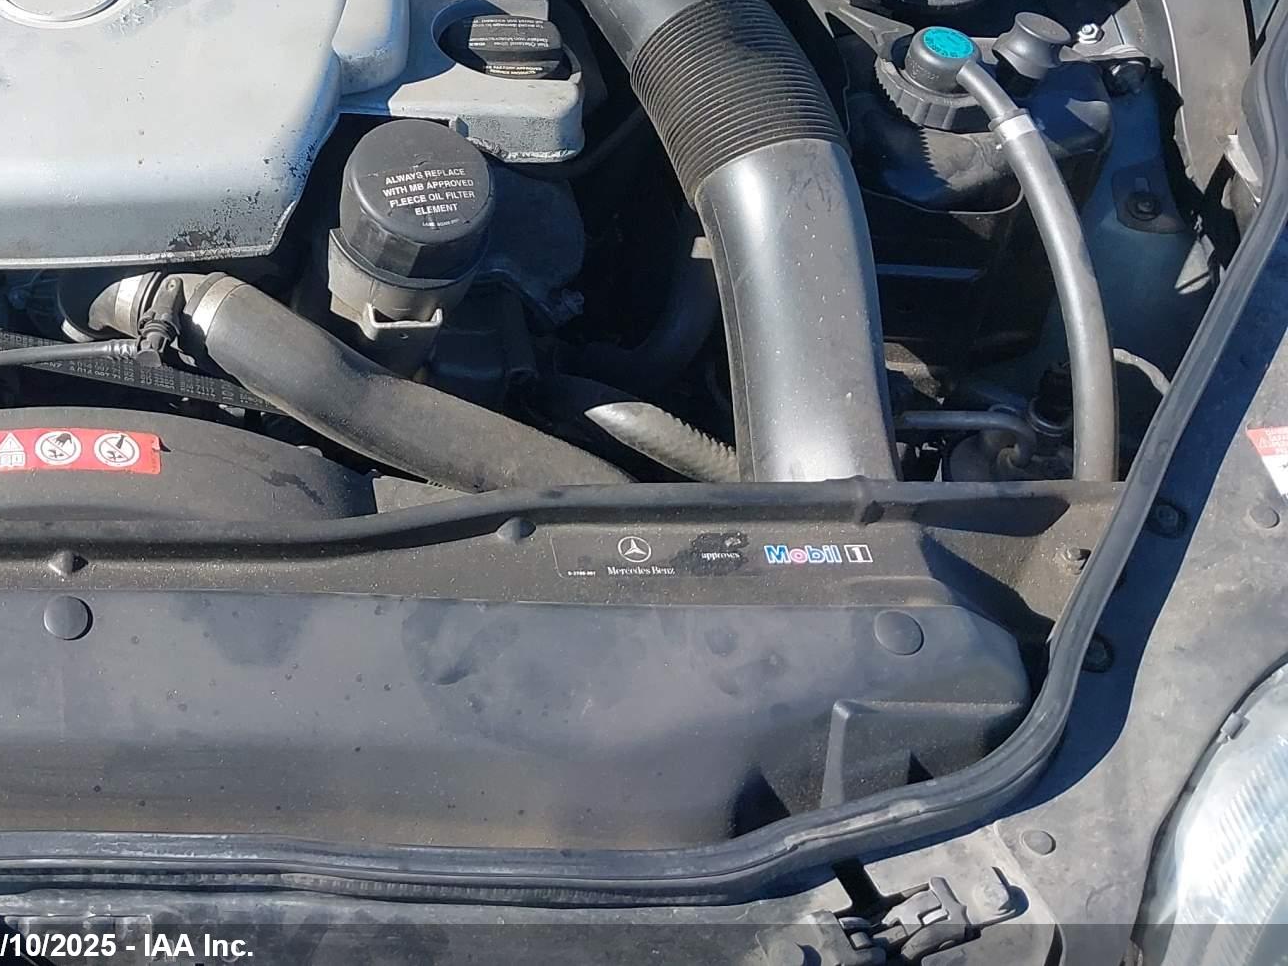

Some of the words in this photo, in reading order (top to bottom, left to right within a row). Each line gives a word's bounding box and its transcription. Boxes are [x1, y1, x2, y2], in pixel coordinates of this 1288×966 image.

[385, 172, 423, 185] ALWAYS
[424, 168, 466, 178] REPLACE
[383, 186, 407, 197] WITH
[409, 183, 424, 191] MB
[427, 179, 474, 189] APPROVED
[389, 195, 427, 208] FLEECE
[428, 193, 444, 201] OIL
[445, 190, 475, 199] FILTER
[415, 203, 458, 216] ELEMENT
[701, 552, 741, 561] approves
[764, 544, 843, 563] Mobil
[607, 566, 651, 575] Mercedes
[652, 566, 675, 575] Benz
